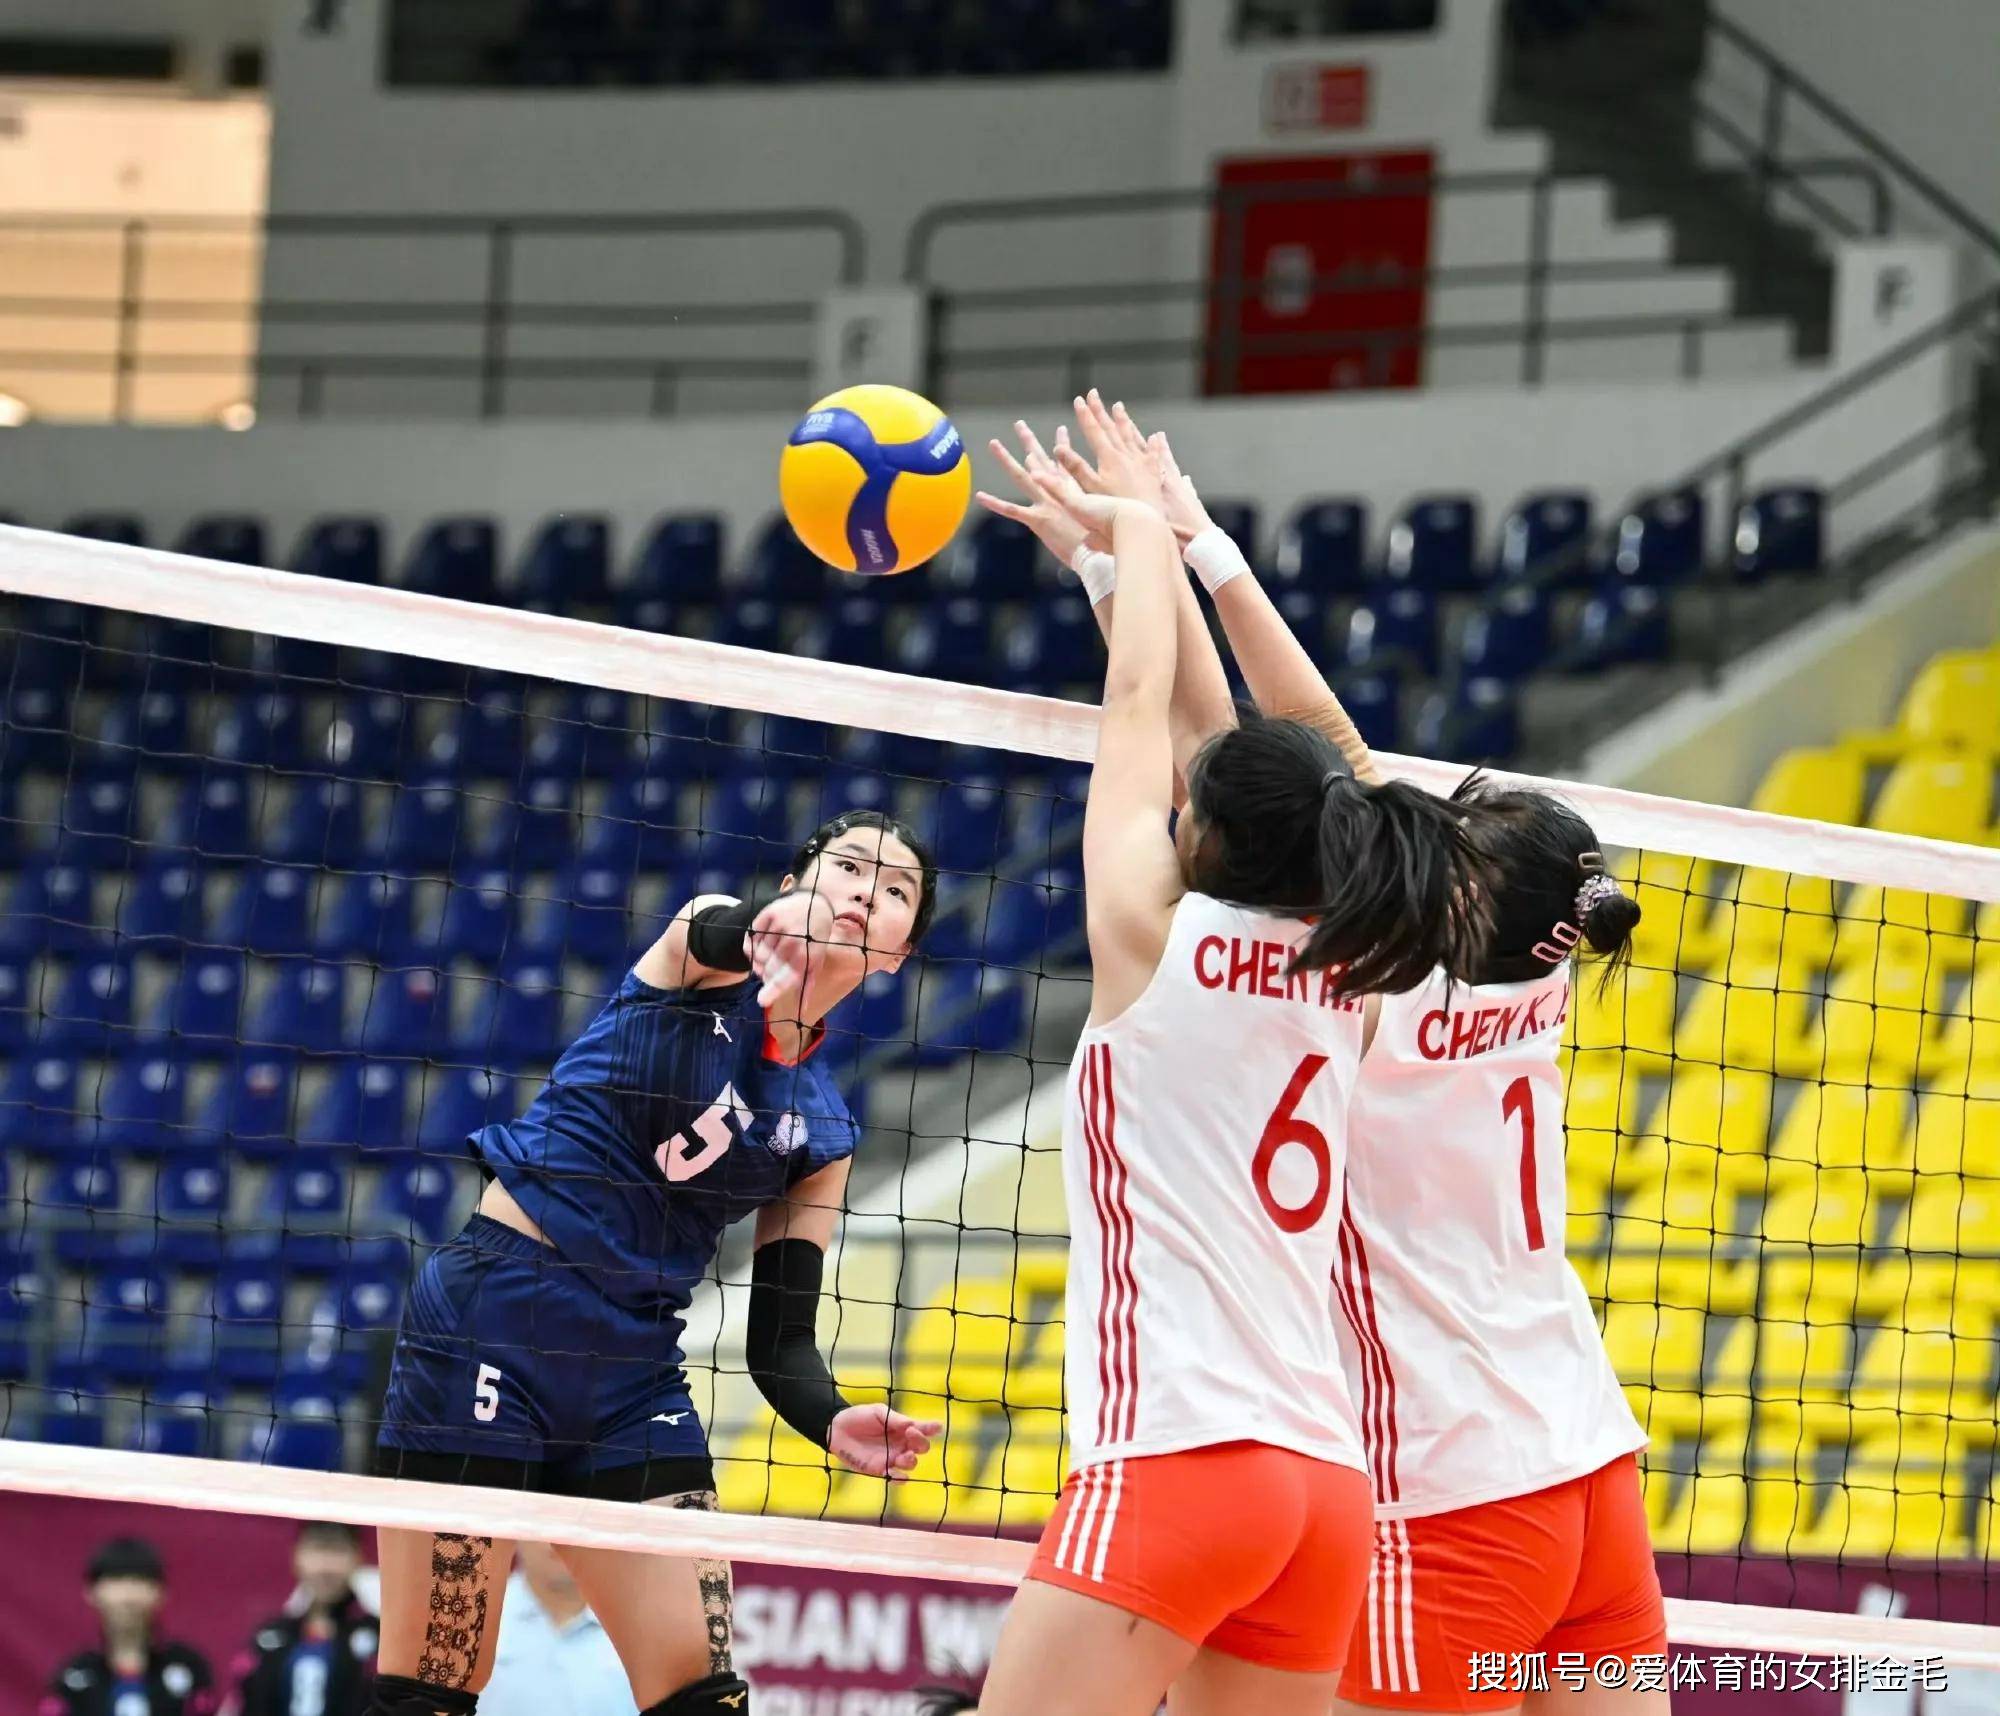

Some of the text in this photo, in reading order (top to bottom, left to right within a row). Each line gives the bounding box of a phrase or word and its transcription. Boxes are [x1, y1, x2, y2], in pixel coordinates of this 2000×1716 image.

[1194, 934, 1307, 1004] CHEN
[1418, 1003, 1523, 1061] CHEN
[654, 1080, 755, 1182] 5
[1251, 1053, 1332, 1234] 6
[1501, 1075, 1546, 1252] 1
[474, 1363, 502, 1423] 5
[732, 1583, 911, 1673] SIAN
